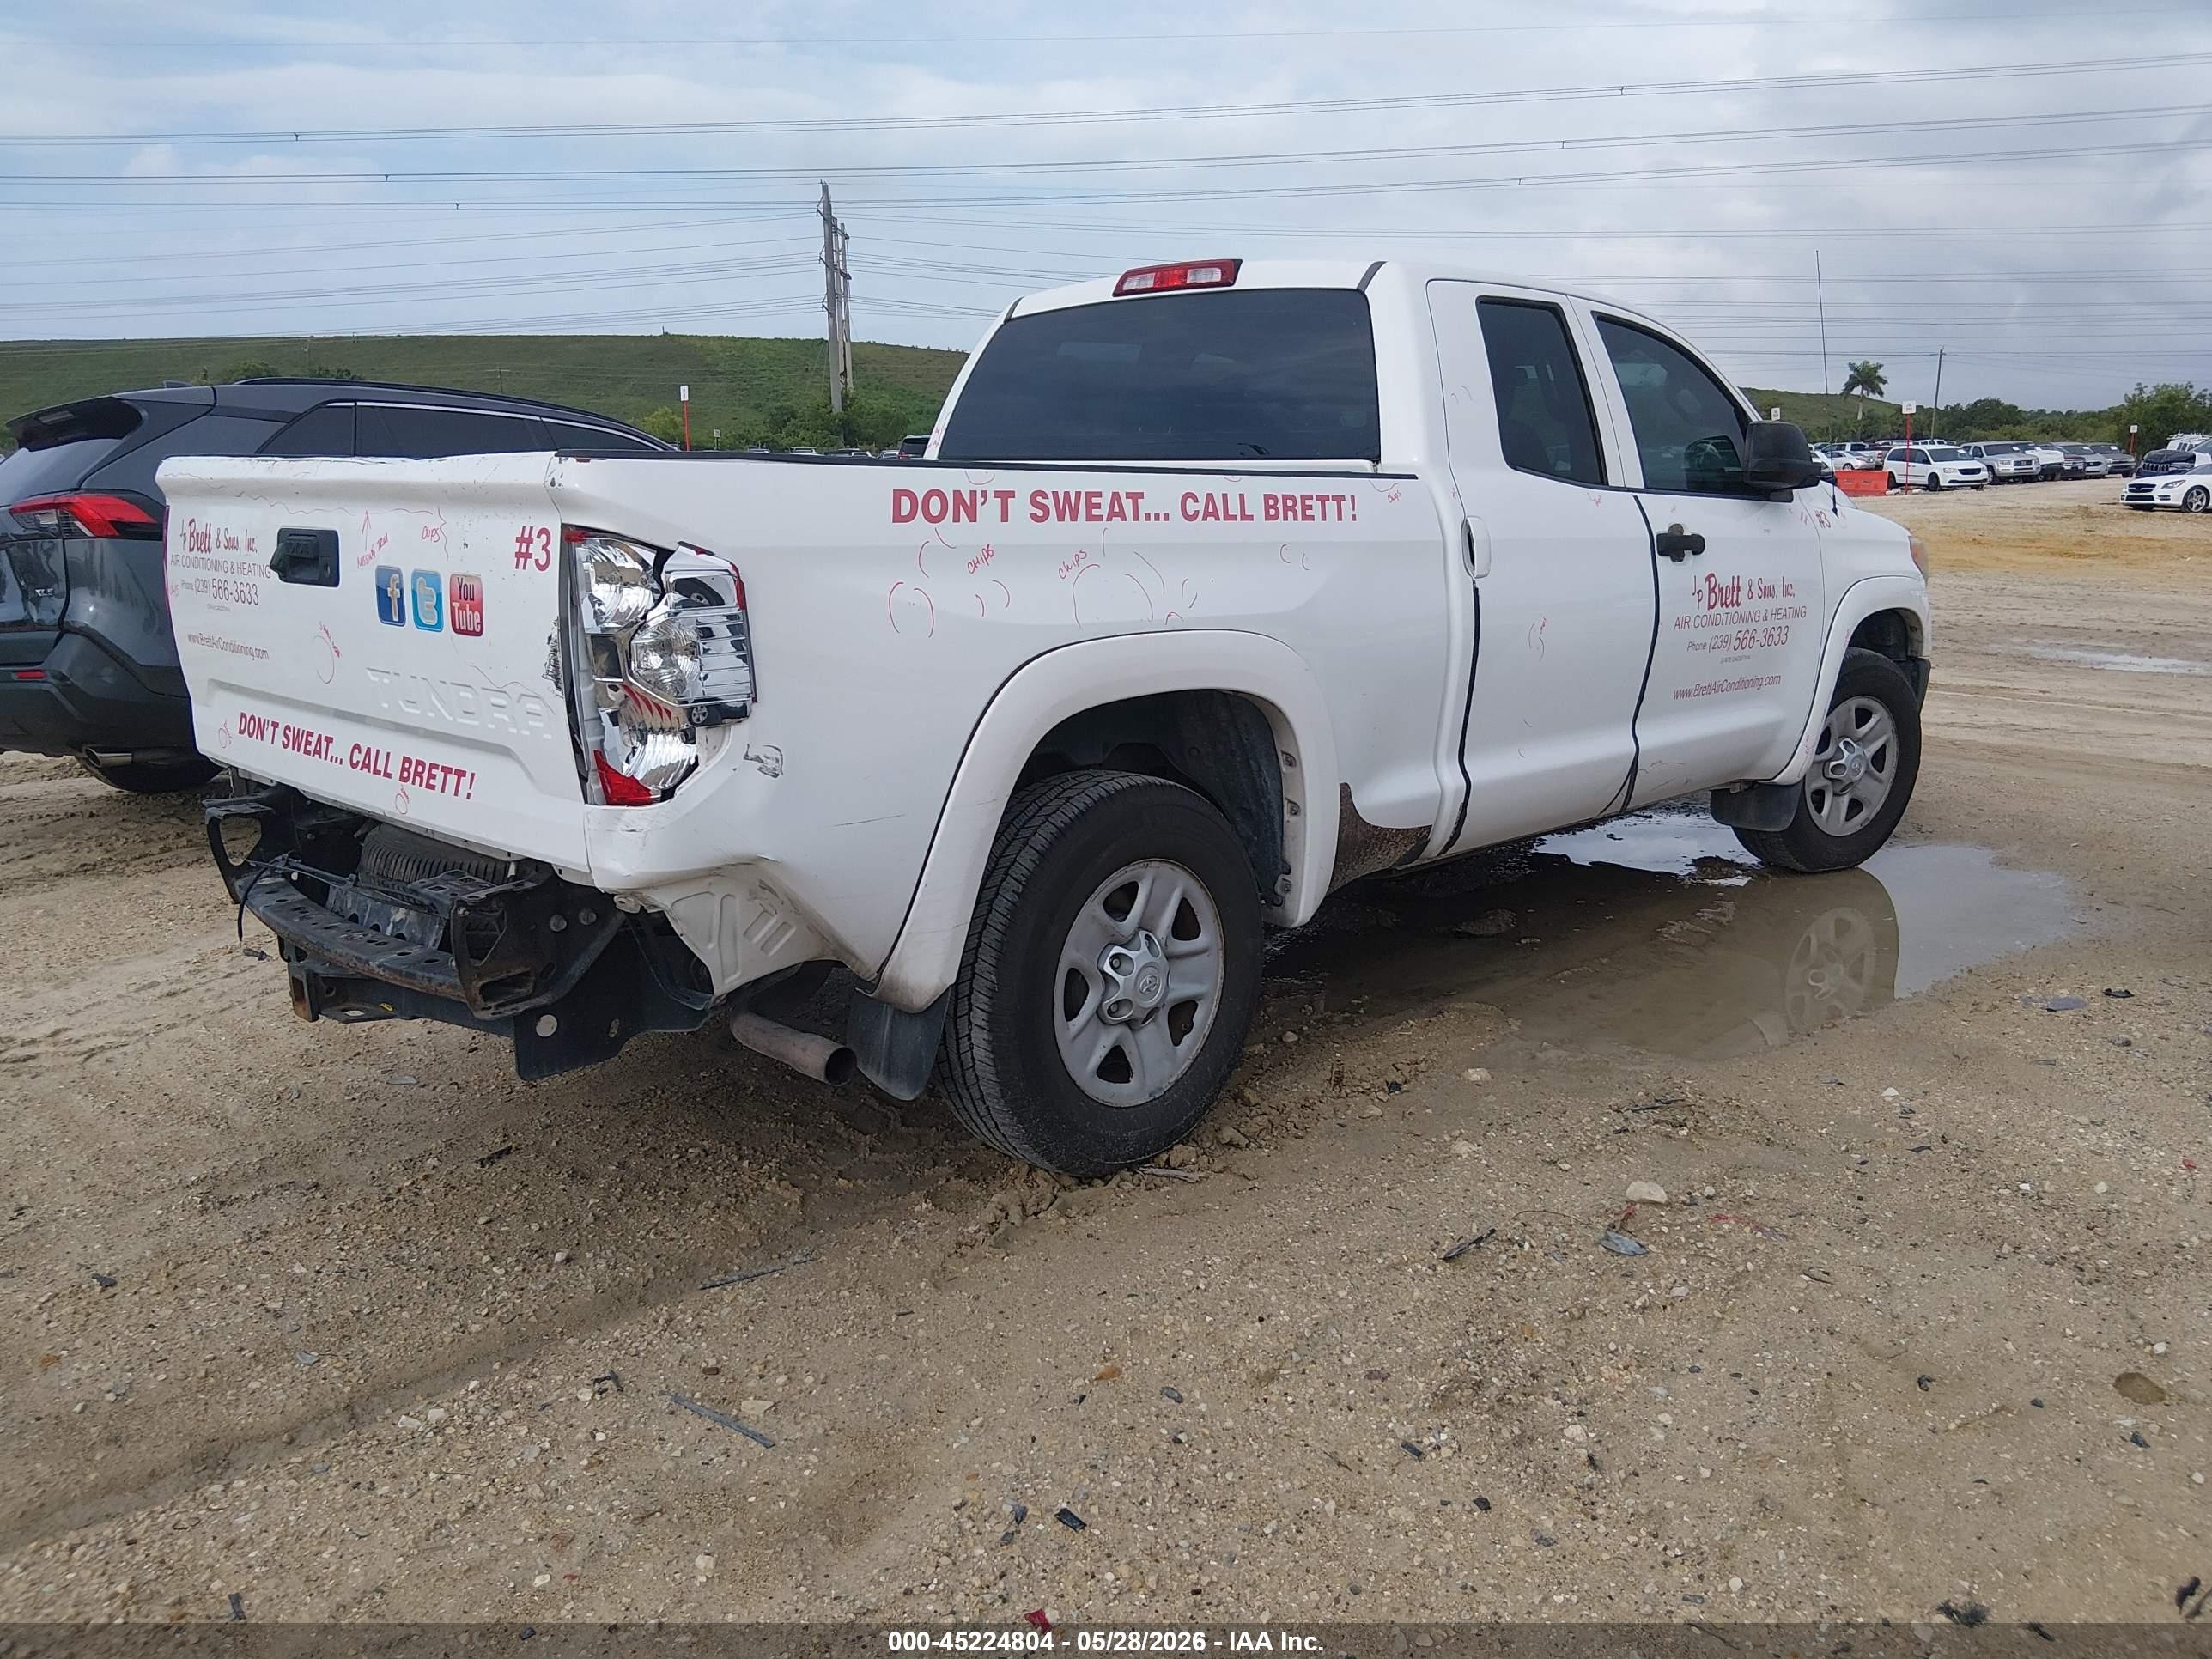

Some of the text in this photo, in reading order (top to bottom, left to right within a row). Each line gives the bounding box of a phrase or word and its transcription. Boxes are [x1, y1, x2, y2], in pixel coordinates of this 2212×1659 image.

[892, 489, 1357, 524] DON'T SWEAT... CALL BRETT!
[188, 518, 212, 554] Brett
[216, 527, 221, 549] &
[245, 529, 258, 554] Inc.
[515, 526, 551, 572] #3
[171, 554, 271, 579] AIR CONDITIONING & HEATING
[212, 578, 259, 605] 566-3633
[457, 576, 475, 601] You
[1705, 572, 1742, 611] Brett
[1747, 578, 1753, 600] &
[1757, 577, 1778, 600] Sons,
[1782, 576, 1796, 599] Inc.
[453, 602, 481, 633] Tube
[1674, 605, 1807, 630] AIR CONDITIONING & HEATING
[1686, 625, 1789, 653] Phone (239) 566-3633
[1674, 674, 1781, 700] www.BrettAirConditioning.com
[366, 667, 557, 739] TUNDRA
[238, 712, 280, 746] DON'T
[281, 724, 343, 766] SWEAT...
[349, 743, 392, 779] CALL
[398, 756, 476, 799] BRETT!
